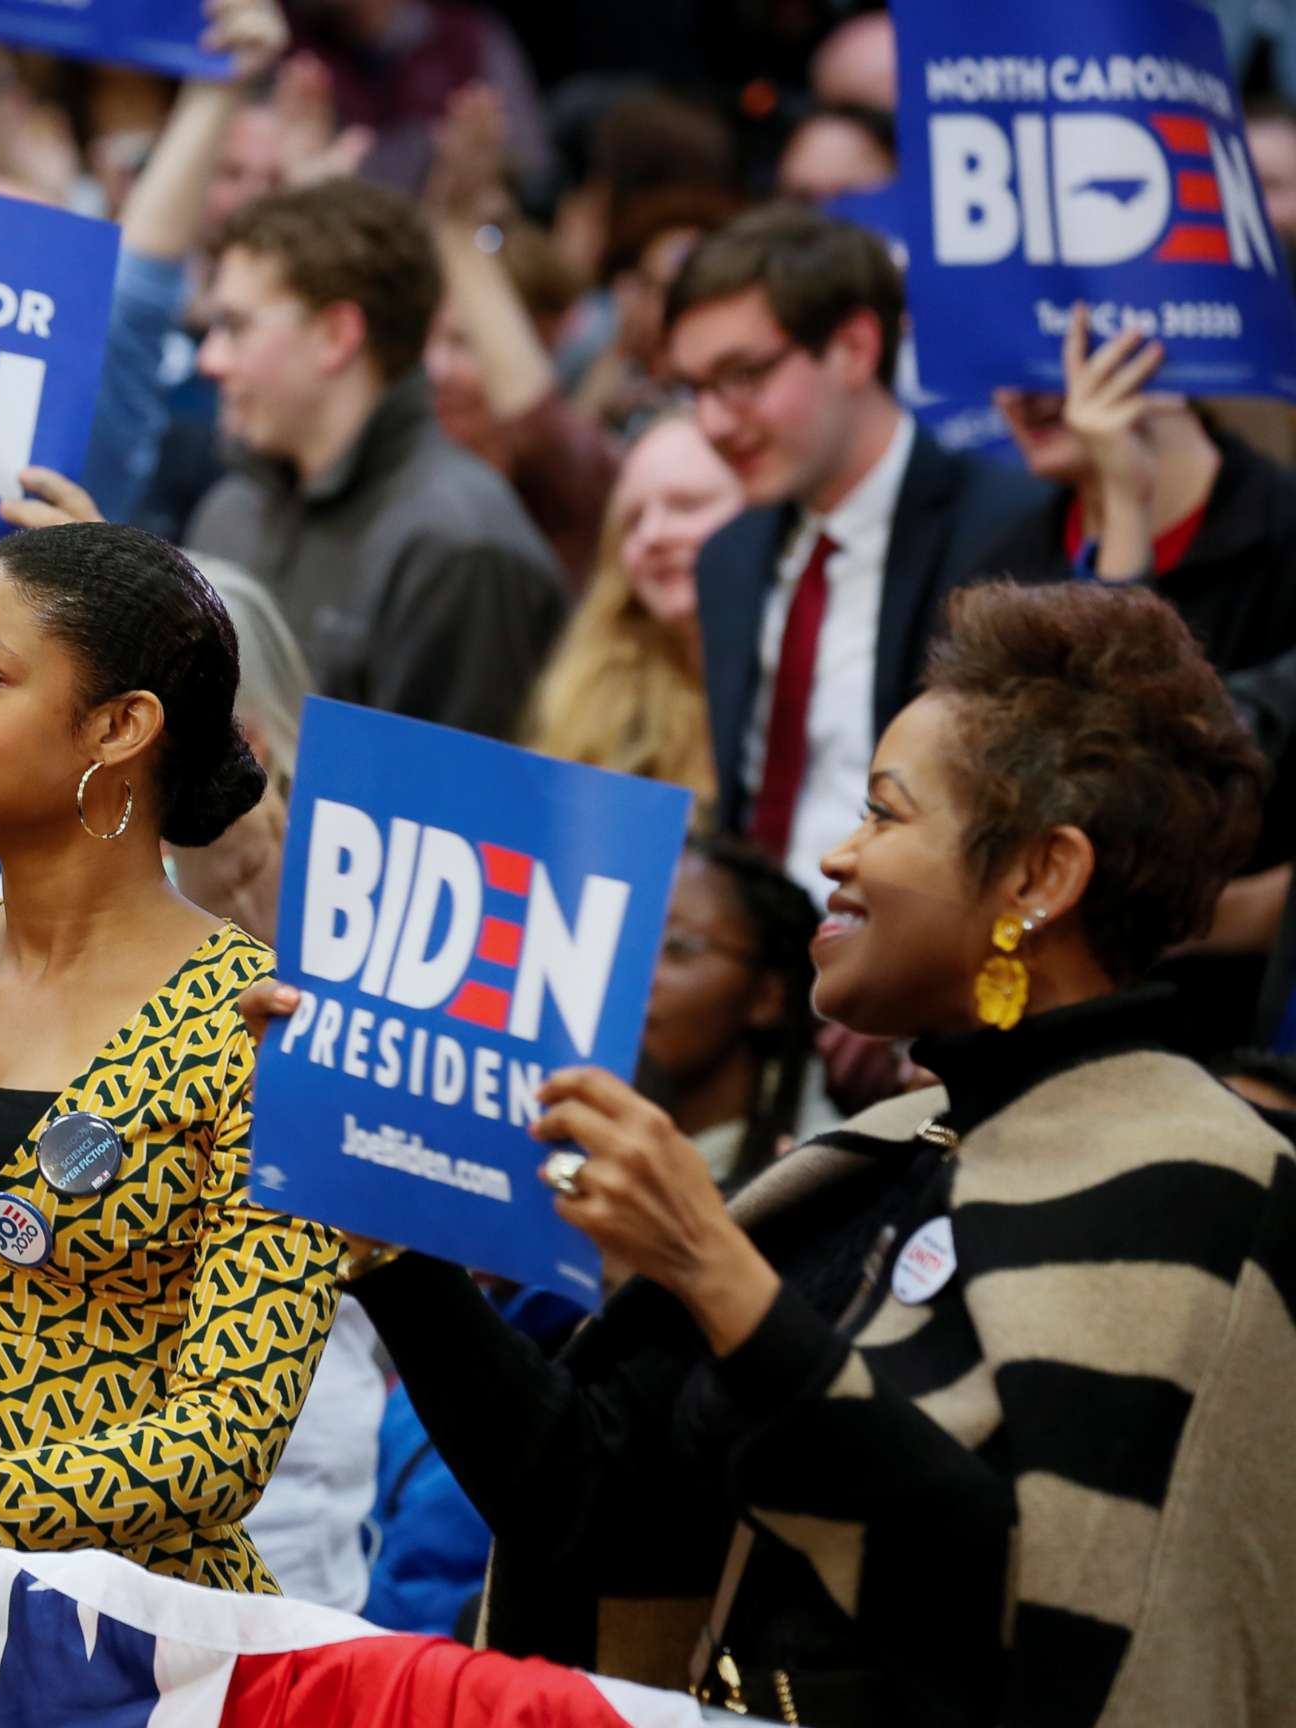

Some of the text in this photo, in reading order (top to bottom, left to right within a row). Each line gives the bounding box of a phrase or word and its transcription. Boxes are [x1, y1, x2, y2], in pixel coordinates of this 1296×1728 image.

[926, 56, 1047, 102] NORTH
[927, 112, 1277, 279] BIDEN
[300, 798, 631, 1058] BIDEN
[280, 989, 543, 1127] PRESIDEN
[60, 1136, 95, 1170] SCIENCE
[57, 1166, 82, 1189] OVER
[11, 1224, 38, 1256] 2020
